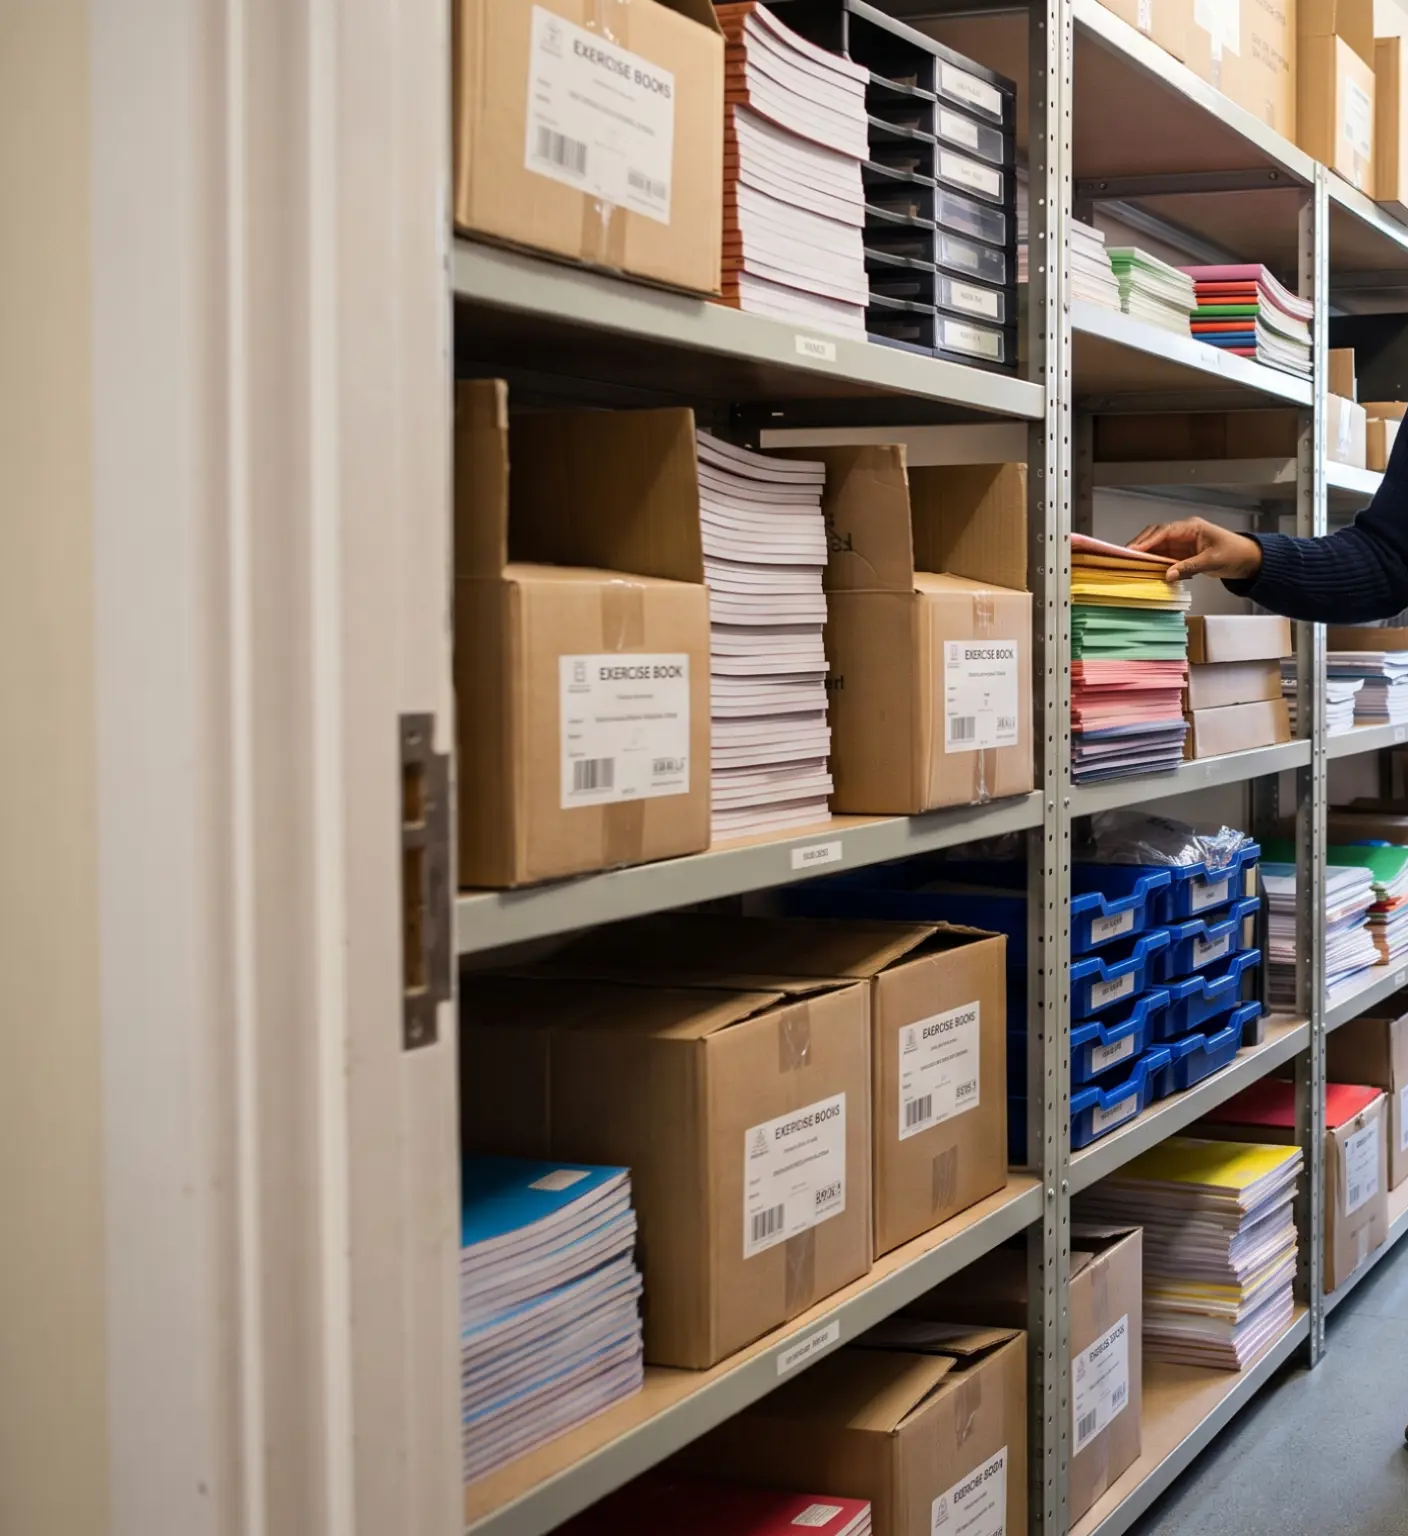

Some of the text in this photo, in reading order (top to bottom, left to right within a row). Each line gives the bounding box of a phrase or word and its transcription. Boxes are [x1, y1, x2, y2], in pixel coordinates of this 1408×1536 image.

[573, 39, 632, 80] EXERCISE
[965, 648, 1014, 660] EXERCISE BOOK
[599, 665, 683, 681] EXERCISE BOOK
[922, 1018, 953, 1040] EXERCISE
[775, 1114, 814, 1141] EXERCISE
